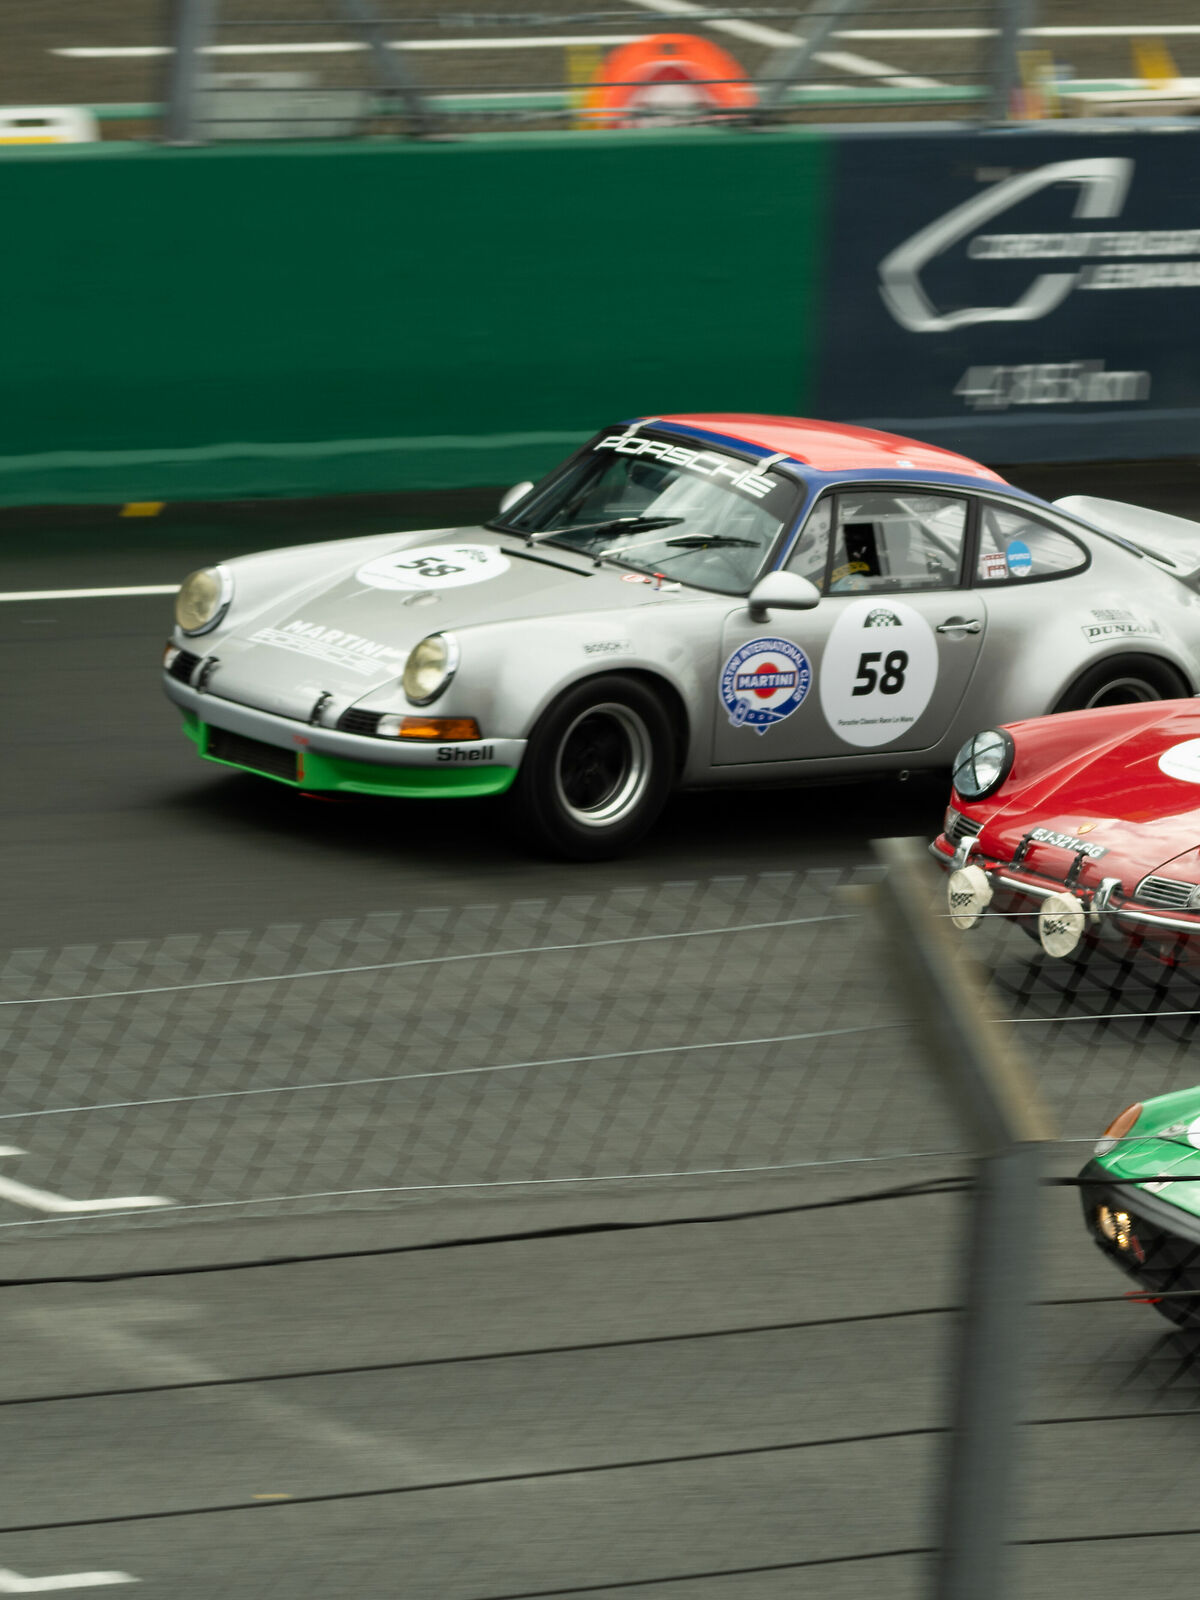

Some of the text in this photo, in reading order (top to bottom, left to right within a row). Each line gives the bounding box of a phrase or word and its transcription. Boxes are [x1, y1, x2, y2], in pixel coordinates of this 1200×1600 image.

[593, 435, 777, 499] PORSCHE
[394, 556, 466, 577] 58
[738, 673, 794, 688] MARTINI
[851, 650, 909, 696] 58
[437, 744, 495, 761] Shell
